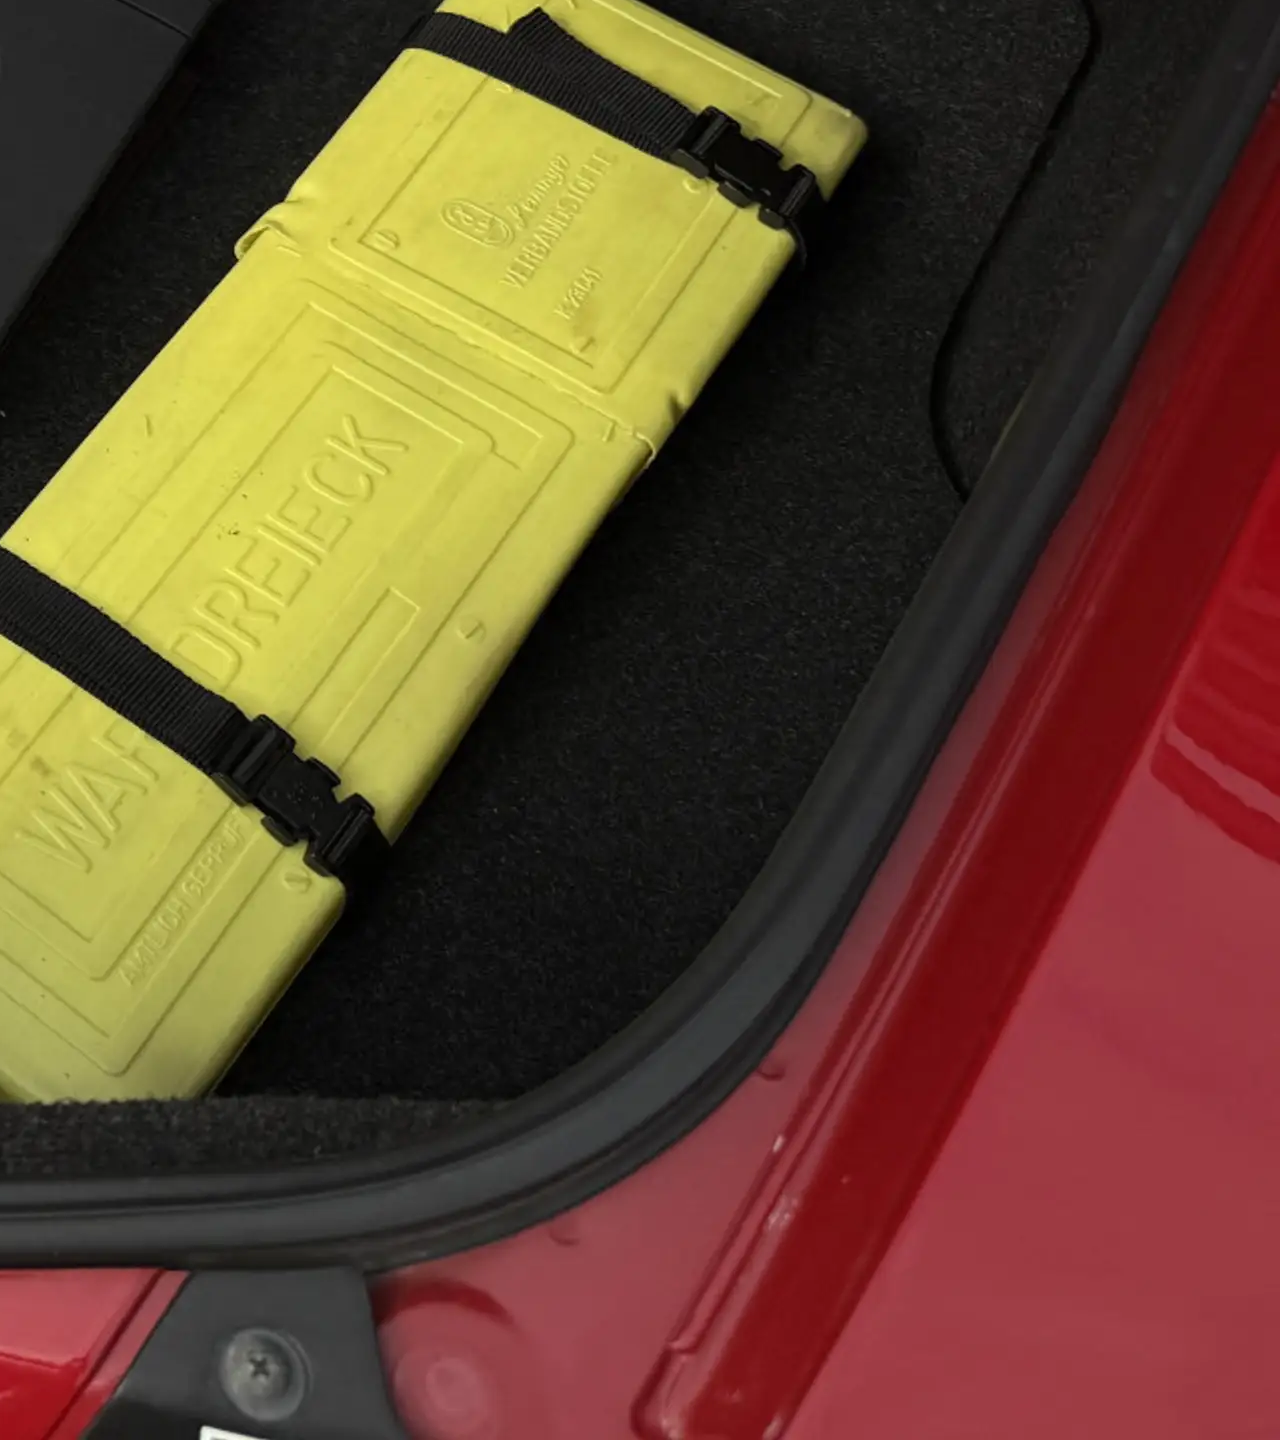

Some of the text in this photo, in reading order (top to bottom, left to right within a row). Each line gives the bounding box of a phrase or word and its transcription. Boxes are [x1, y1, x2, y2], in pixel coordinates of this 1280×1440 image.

[7, 415, 410, 872] WARDREIECK
[117, 816, 252, 985] AMTLICH GEPRÜF
